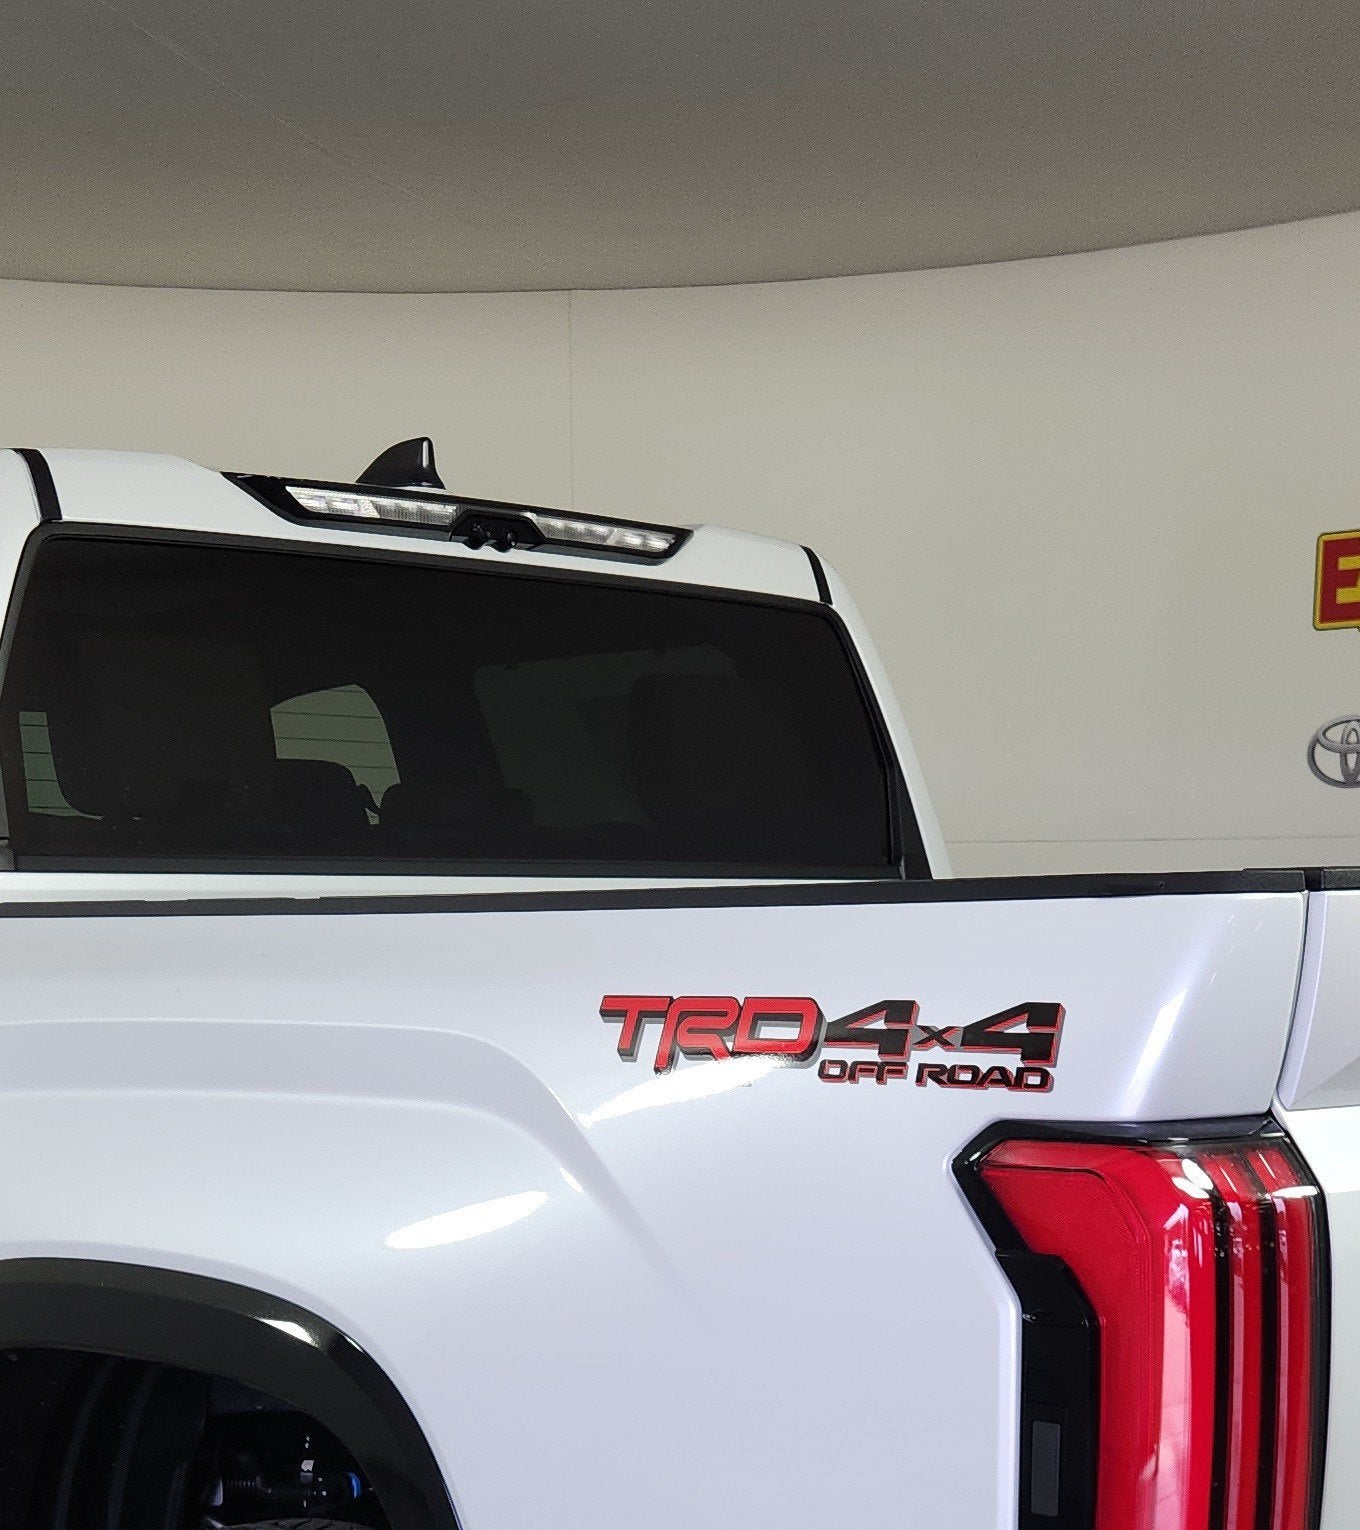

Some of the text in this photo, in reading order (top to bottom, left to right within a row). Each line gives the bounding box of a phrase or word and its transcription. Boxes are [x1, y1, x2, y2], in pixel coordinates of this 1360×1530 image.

[600, 994, 826, 1075] TRD
[818, 1059, 1055, 1093] OFF ROAD
